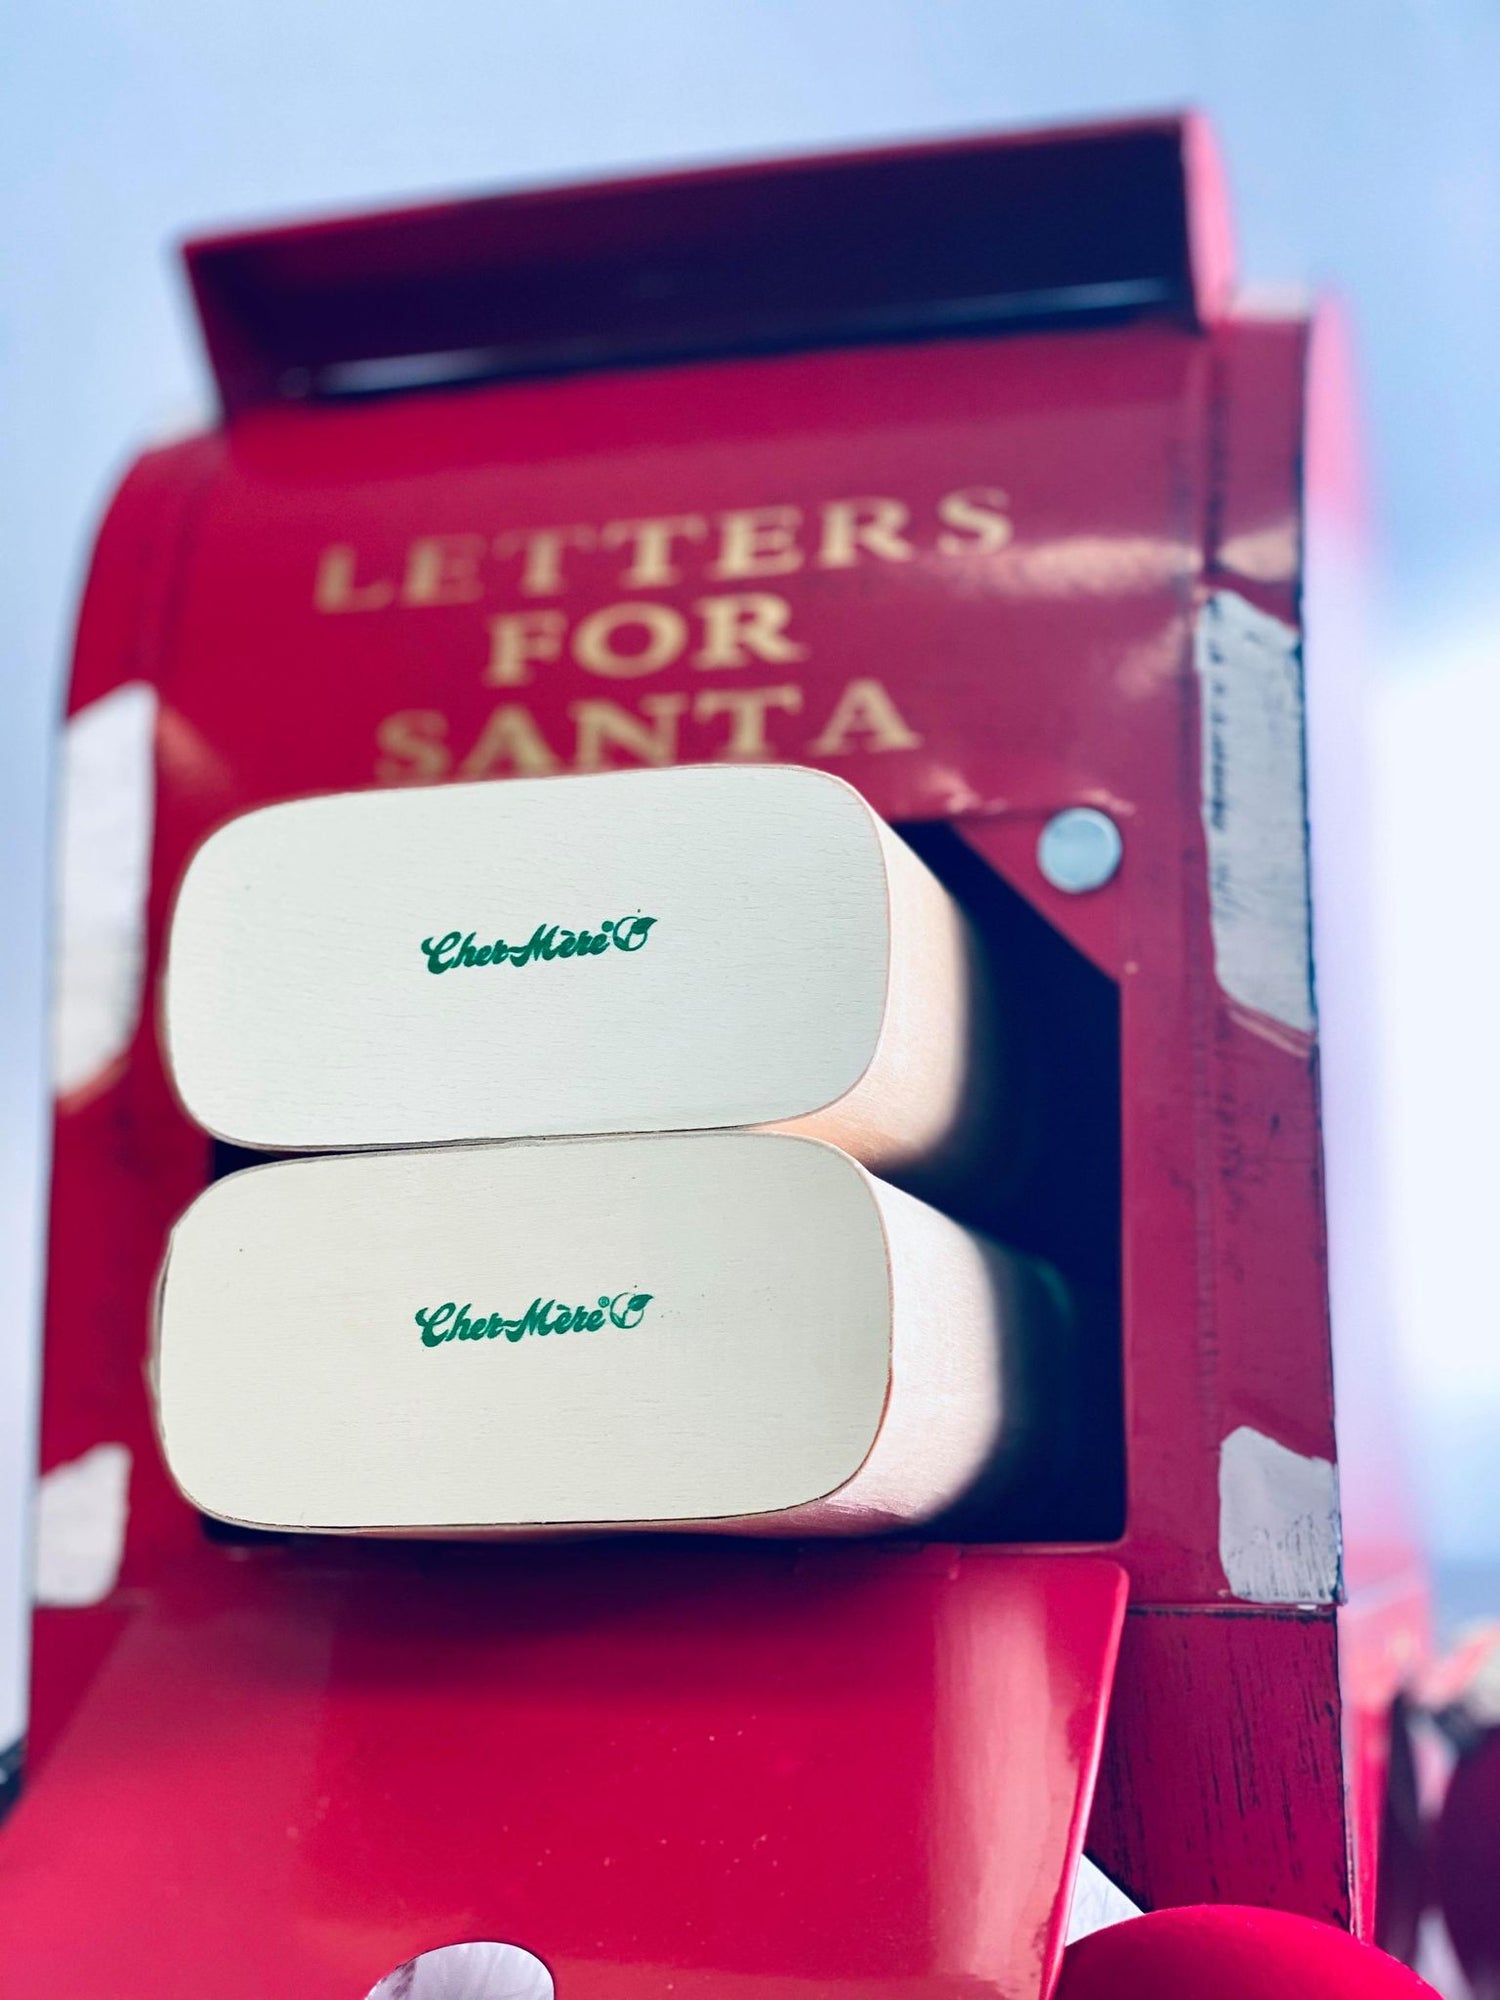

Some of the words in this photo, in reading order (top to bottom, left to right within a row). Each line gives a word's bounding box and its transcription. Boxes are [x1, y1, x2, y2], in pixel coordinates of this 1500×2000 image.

[314, 487, 1013, 613] LETTERS
[485, 592, 807, 688] FOR
[376, 677, 922, 784] SANTA
